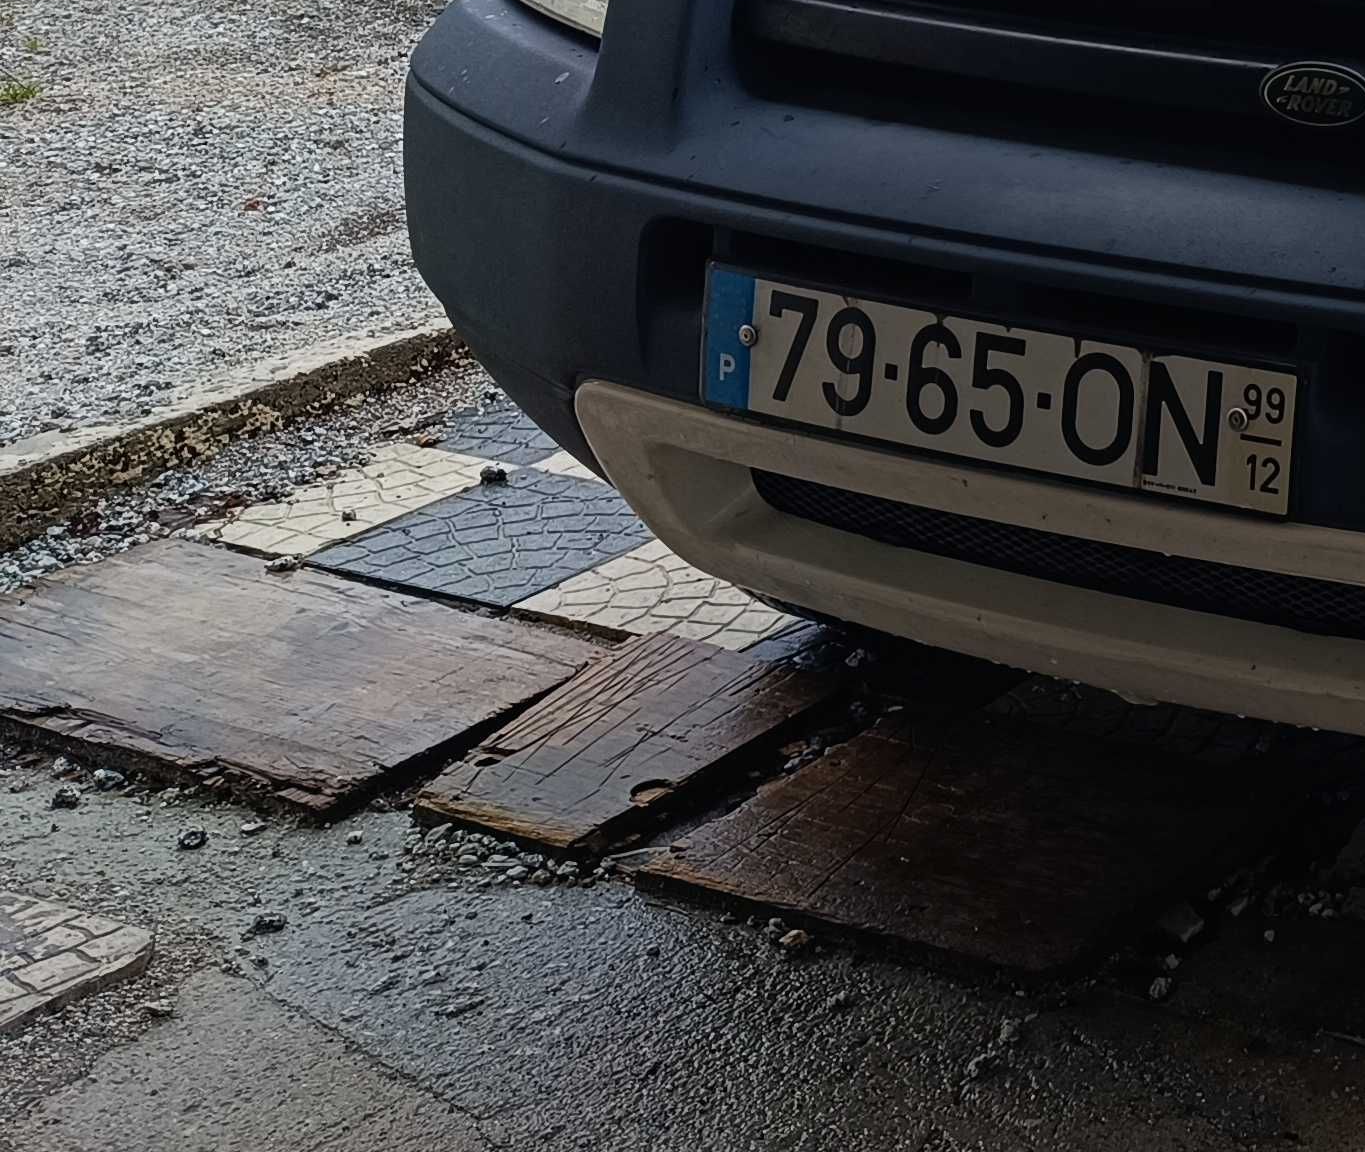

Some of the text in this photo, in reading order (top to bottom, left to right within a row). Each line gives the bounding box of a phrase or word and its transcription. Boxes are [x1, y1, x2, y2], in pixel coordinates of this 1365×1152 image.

[1283, 74, 1337, 96] LAND
[1286, 94, 1353, 117] ROVER
[719, 353, 735, 381] P
[1243, 383, 1286, 424] 99
[1246, 453, 1280, 495] 12
